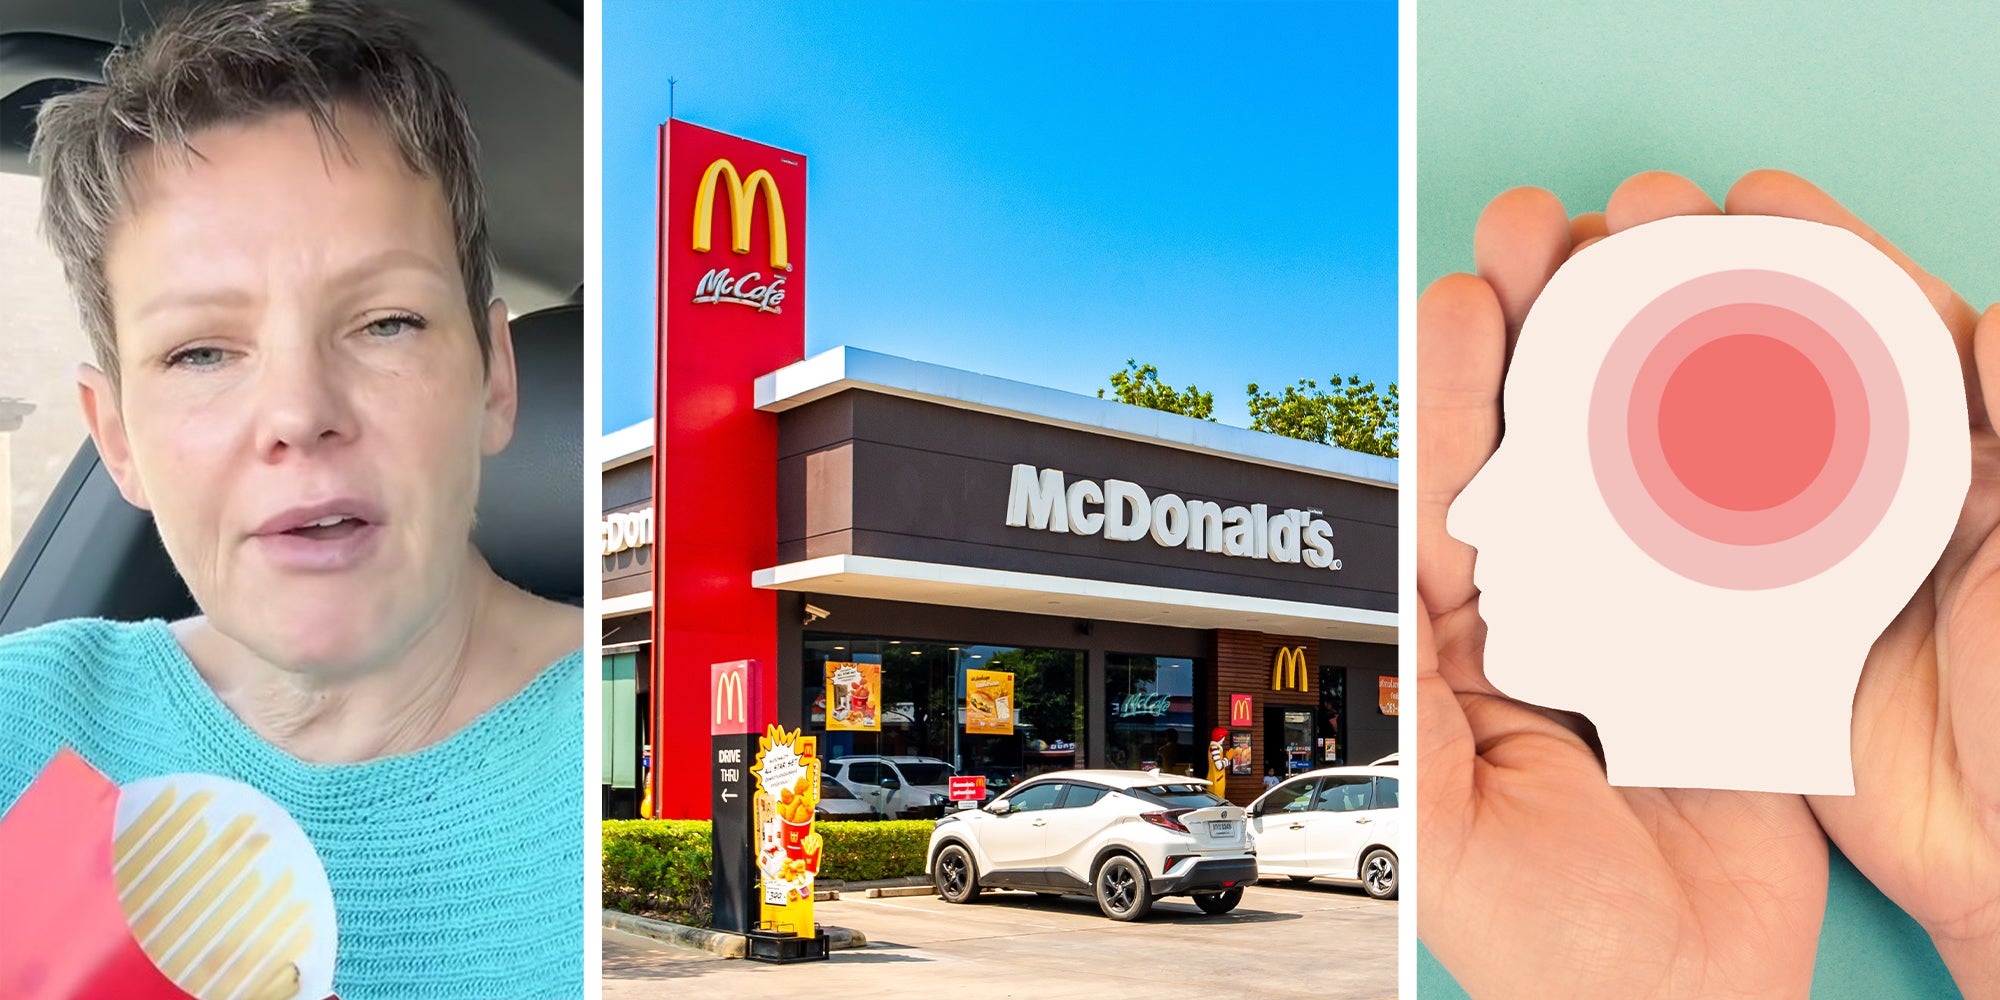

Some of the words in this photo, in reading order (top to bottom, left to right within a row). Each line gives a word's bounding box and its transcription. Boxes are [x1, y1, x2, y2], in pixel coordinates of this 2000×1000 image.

[695, 268, 786, 312] McCafé
[1006, 463, 1335, 569] McDonald's
[718, 749, 741, 763] DRIVE
[720, 768, 739, 782] THRU
